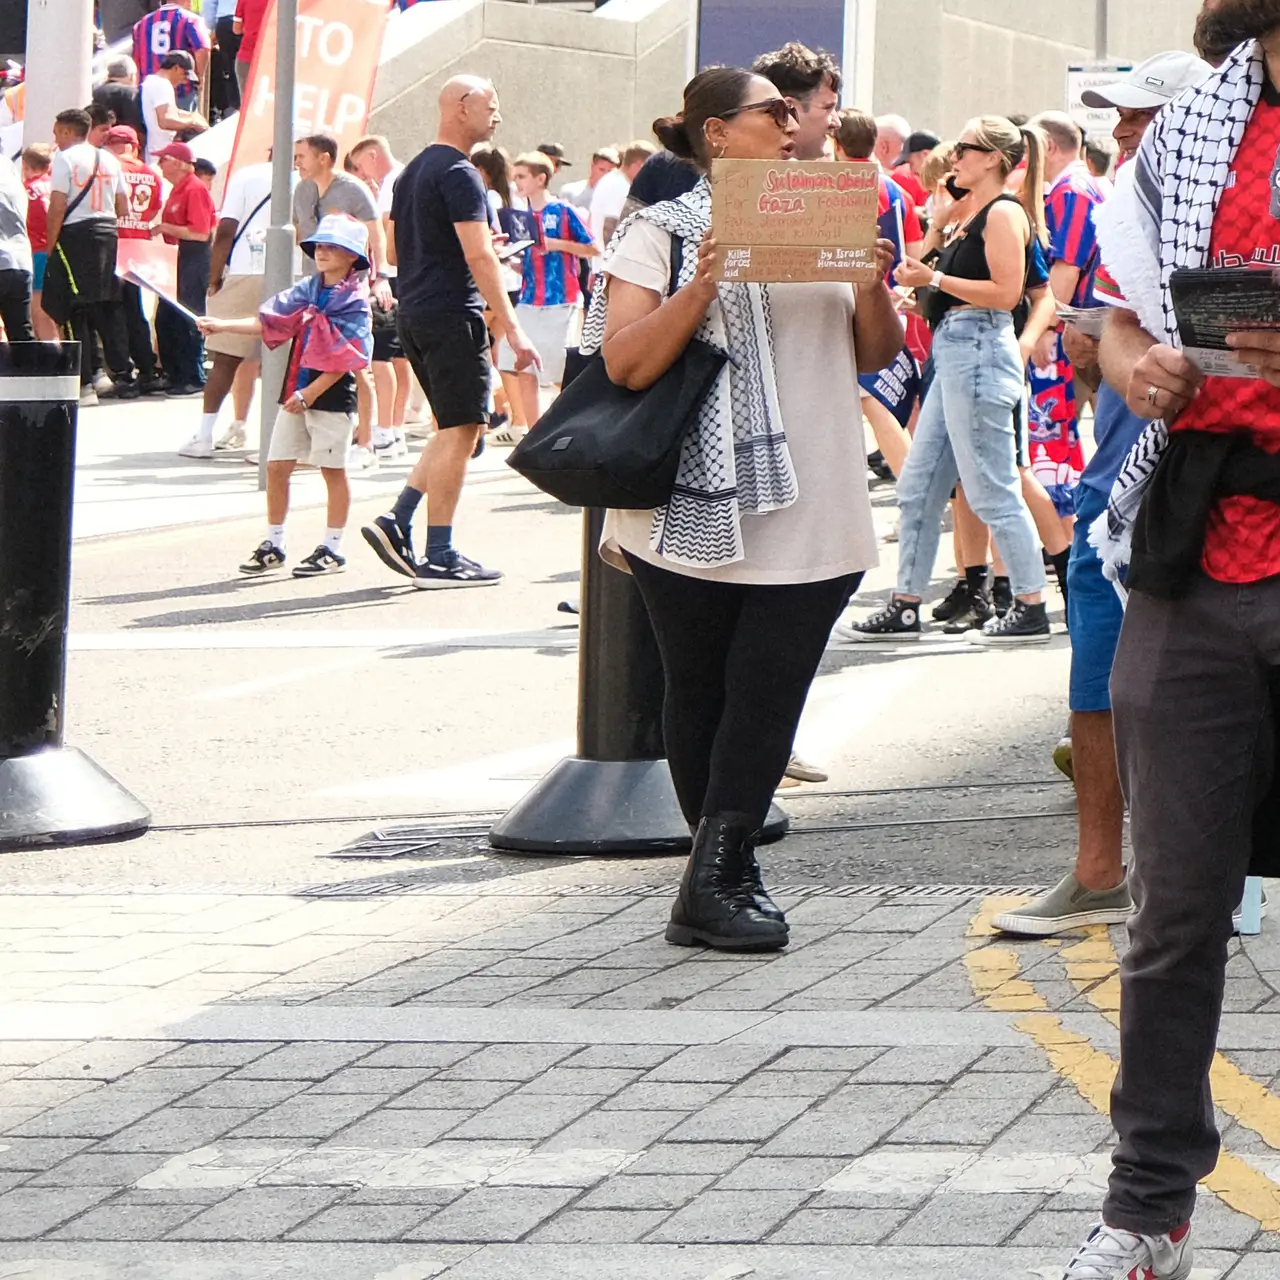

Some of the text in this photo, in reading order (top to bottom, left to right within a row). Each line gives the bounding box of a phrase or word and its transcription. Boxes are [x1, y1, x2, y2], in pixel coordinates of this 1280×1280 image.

[151, 20, 171, 56] 6
[295, 15, 354, 66] TO
[758, 193, 805, 214] Gaza
[724, 258, 752, 268] forces
[728, 247, 752, 259] Killed
[821, 248, 834, 260] by
[724, 269, 739, 278] aid
[873, 377, 900, 407] SOUTH
[878, 368, 907, 401] LONDON
